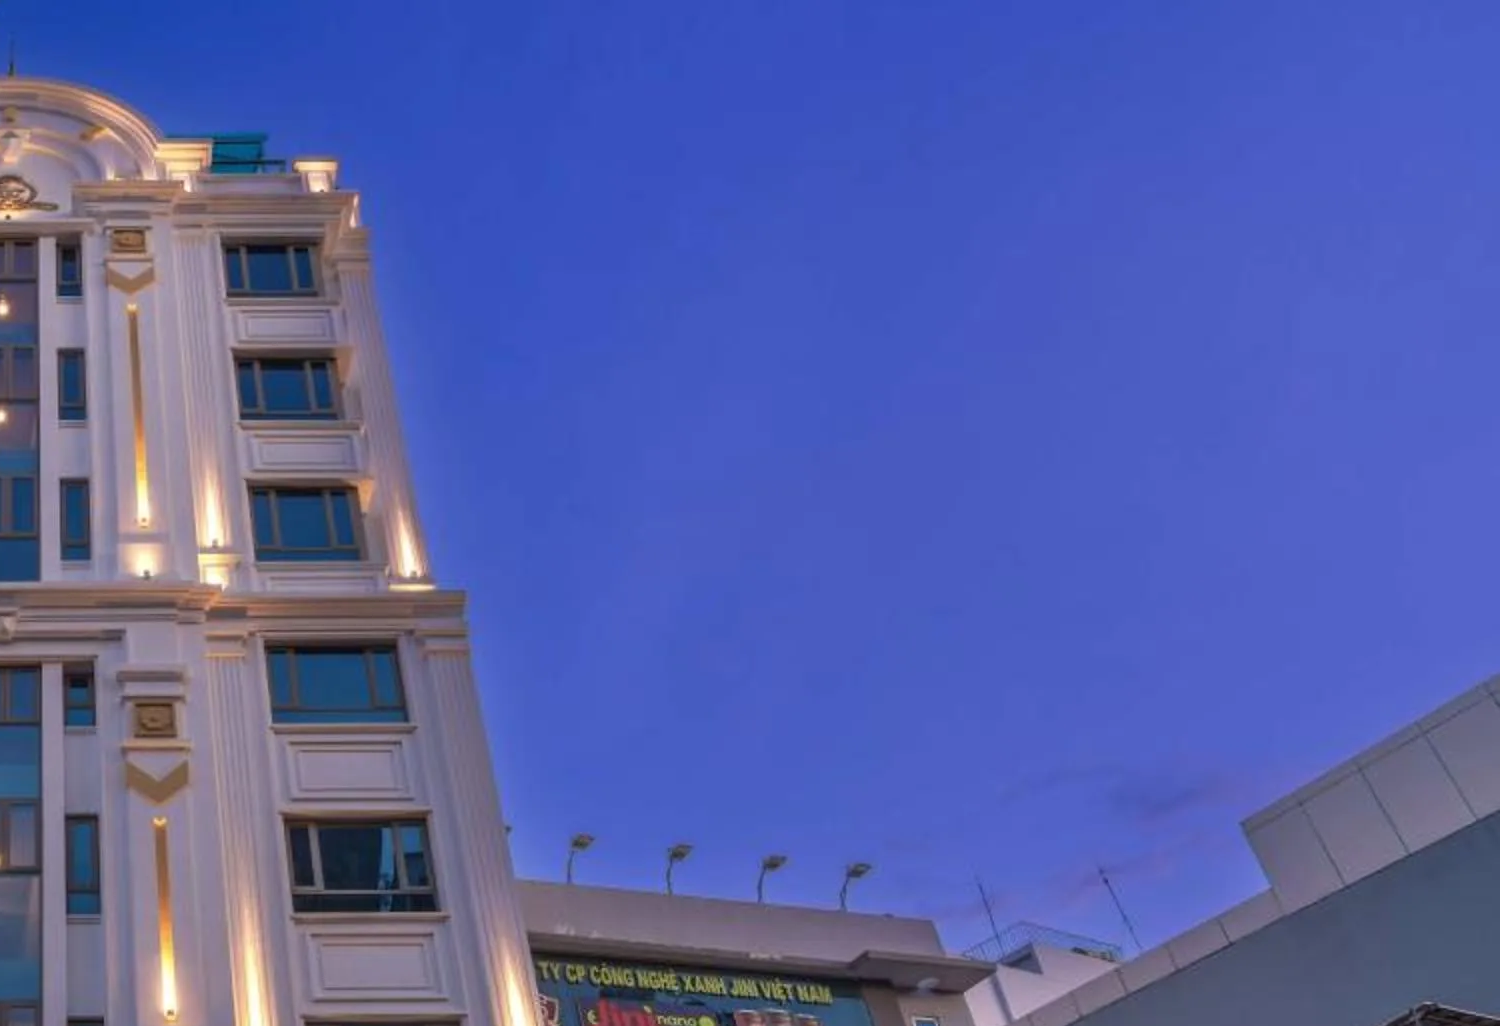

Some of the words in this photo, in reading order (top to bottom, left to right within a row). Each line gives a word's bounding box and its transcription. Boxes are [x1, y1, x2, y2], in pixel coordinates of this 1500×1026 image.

[539, 962, 560, 980] TY
[566, 965, 585, 982] CP
[797, 985, 833, 1004] NAM
